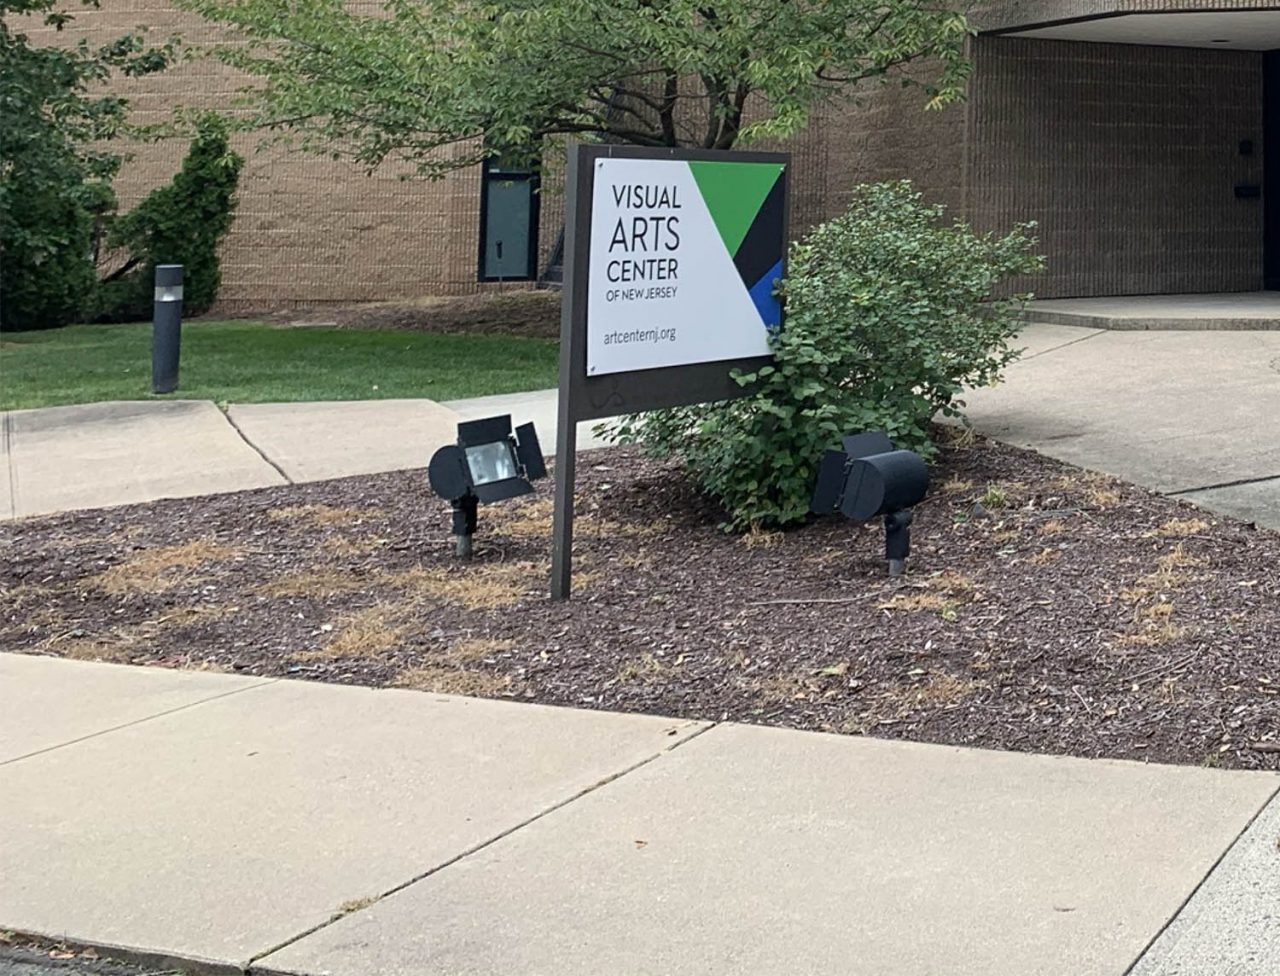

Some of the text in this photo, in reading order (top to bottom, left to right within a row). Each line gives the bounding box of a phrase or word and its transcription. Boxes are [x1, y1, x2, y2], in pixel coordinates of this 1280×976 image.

[612, 184, 682, 209] VISUAL
[608, 216, 680, 253] ARTS
[607, 258, 679, 283] CENTER
[606, 286, 678, 302] OF NEW JERSEY
[603, 326, 676, 345] artcenternj.org
